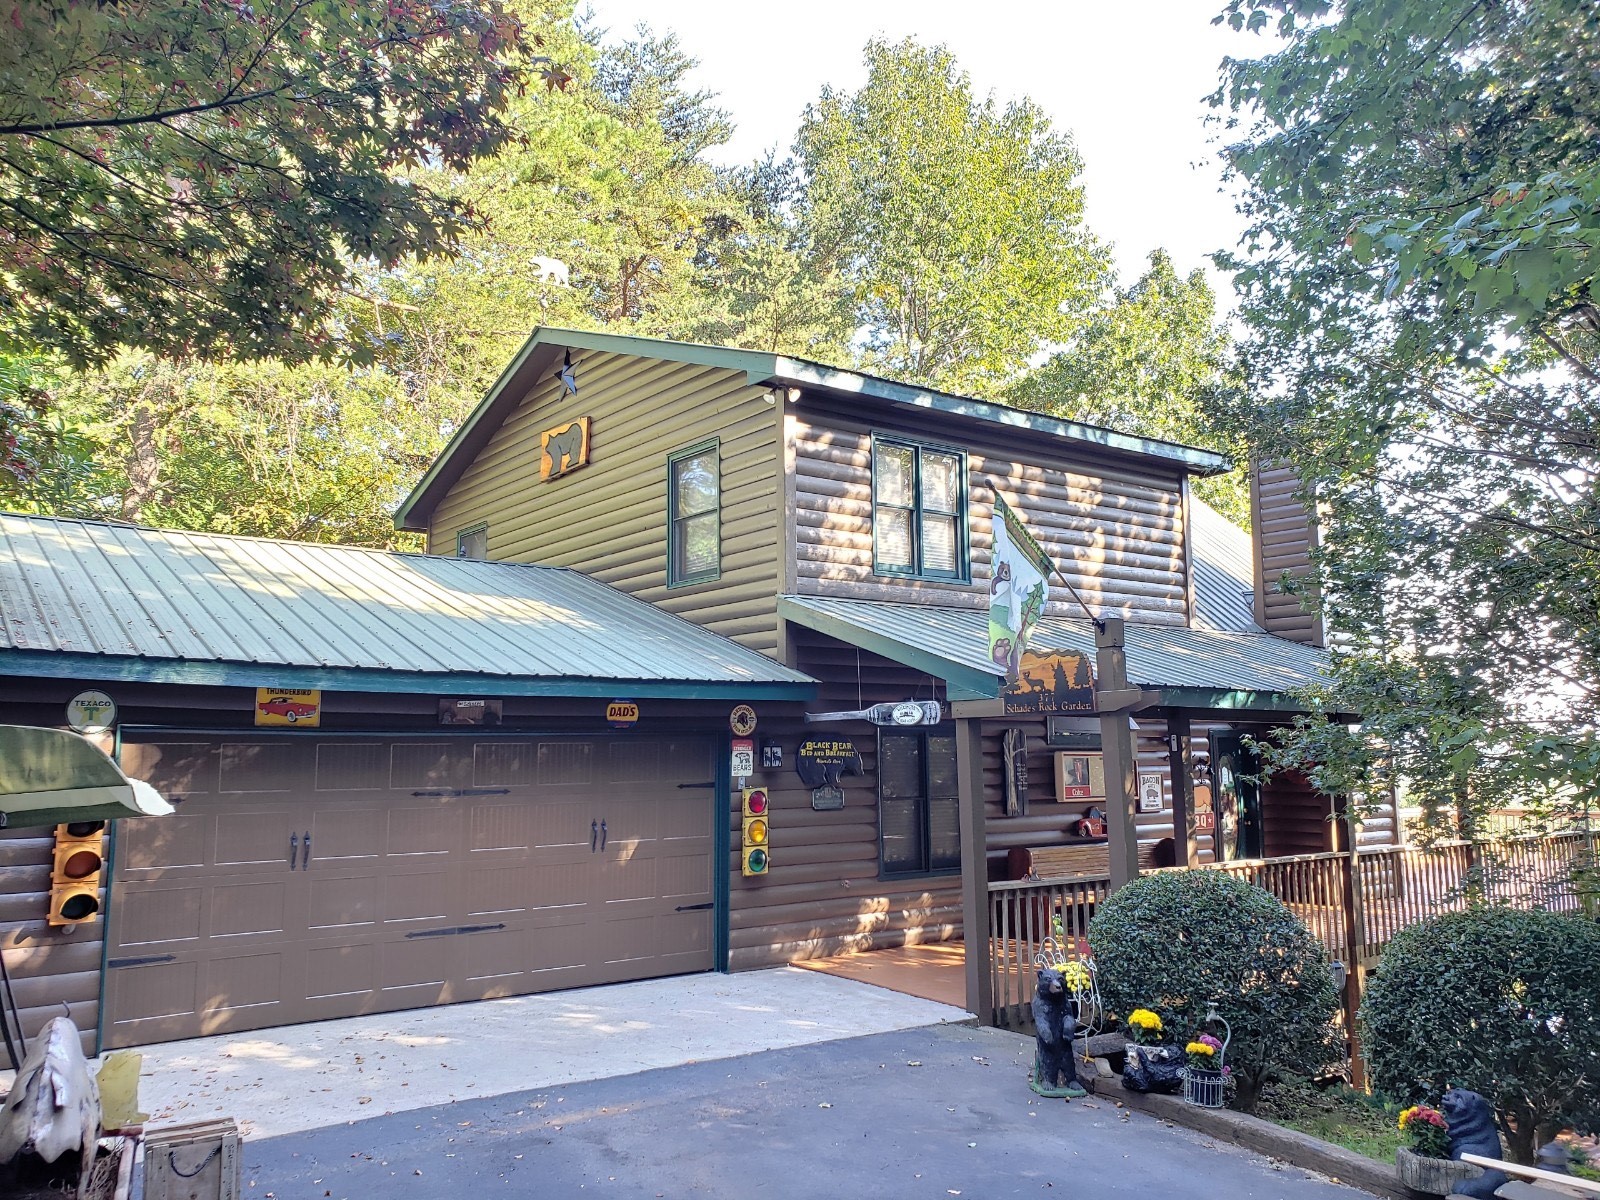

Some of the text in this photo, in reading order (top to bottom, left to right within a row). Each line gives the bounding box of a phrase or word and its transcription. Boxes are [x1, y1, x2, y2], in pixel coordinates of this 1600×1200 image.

[1038, 701, 1057, 711] Rock
[609, 705, 635, 716] DAD'S
[805, 742, 852, 750] BLACK BEAR
[825, 749, 854, 757] BREAKFAST
[1142, 776, 1160, 785] BACON
[1071, 788, 1084, 796] Coke
